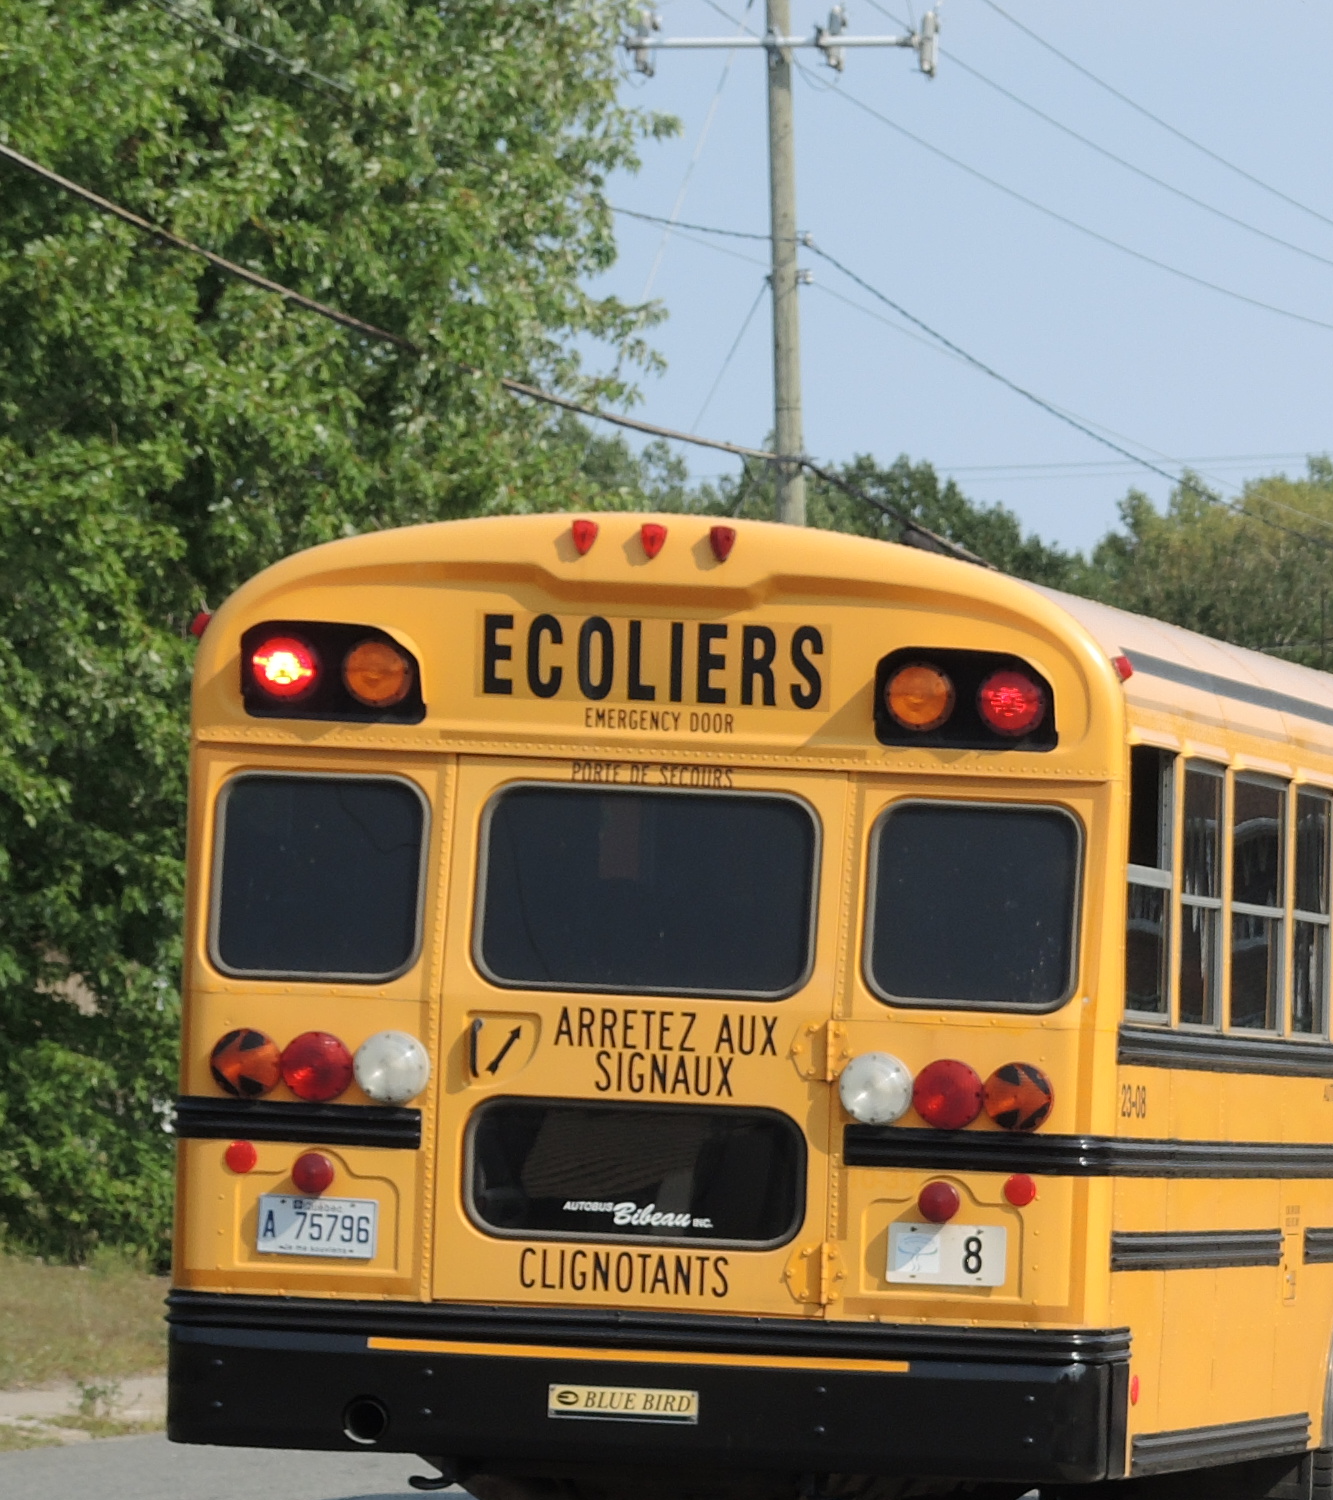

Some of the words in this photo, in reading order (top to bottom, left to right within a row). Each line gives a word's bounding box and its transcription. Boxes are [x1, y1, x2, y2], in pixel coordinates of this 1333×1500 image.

[482, 612, 824, 710] ECOLIERS
[584, 707, 682, 732] EMERGENCY
[690, 712, 735, 734] DOOR
[571, 761, 620, 783] PORTE
[630, 763, 650, 785] DE
[659, 765, 734, 789] SECOURS
[554, 1006, 697, 1052] ARRETEZ
[715, 1013, 778, 1056] AUX
[595, 1050, 734, 1097] SIGNAUX
[1121, 1083, 1147, 1119] 23-08
[263, 1209, 276, 1238] A
[295, 1211, 370, 1244] 75796
[563, 1200, 614, 1213] AUTOBUS
[612, 1201, 692, 1228] Bibeau
[519, 1247, 730, 1298] CLIGNOTANTS
[962, 1235, 983, 1275] 8
[583, 1390, 637, 1411] BLUE
[641, 1393, 692, 1413] BIRD
